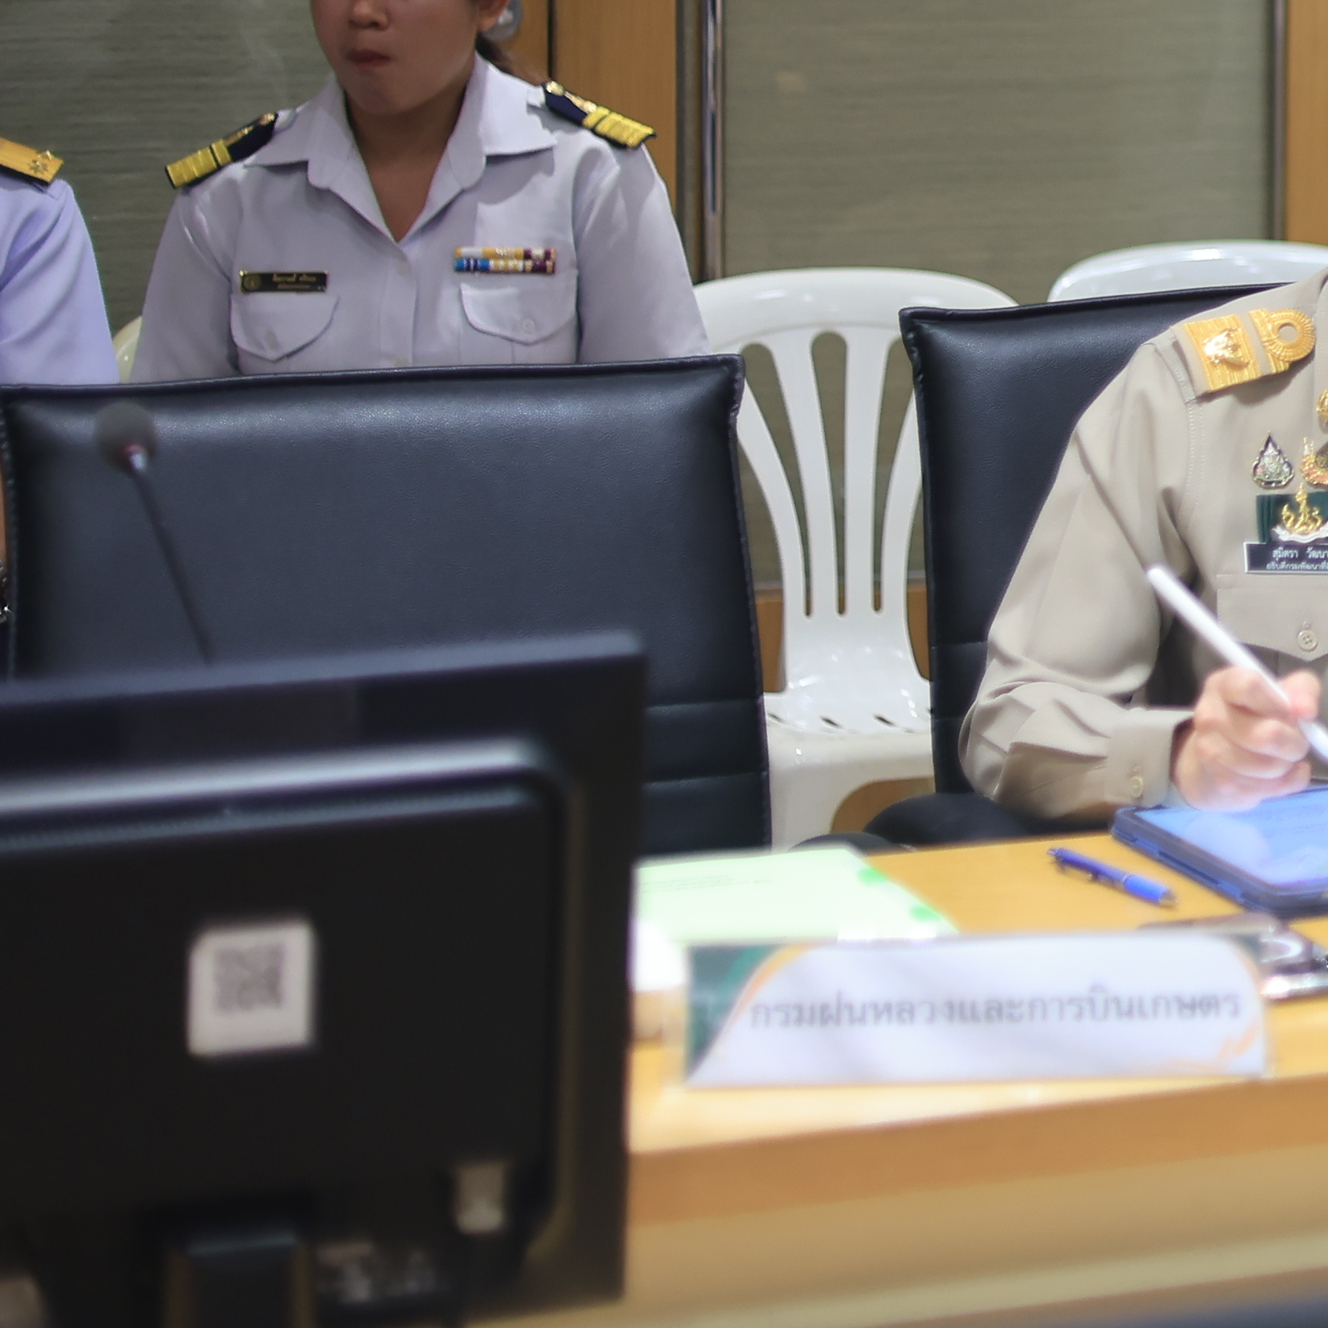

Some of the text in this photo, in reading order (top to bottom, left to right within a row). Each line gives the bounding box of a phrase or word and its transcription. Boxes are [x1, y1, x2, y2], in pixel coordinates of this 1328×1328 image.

[750, 983, 1240, 1028] กรมฝนหลวงและการบินเกษตร
